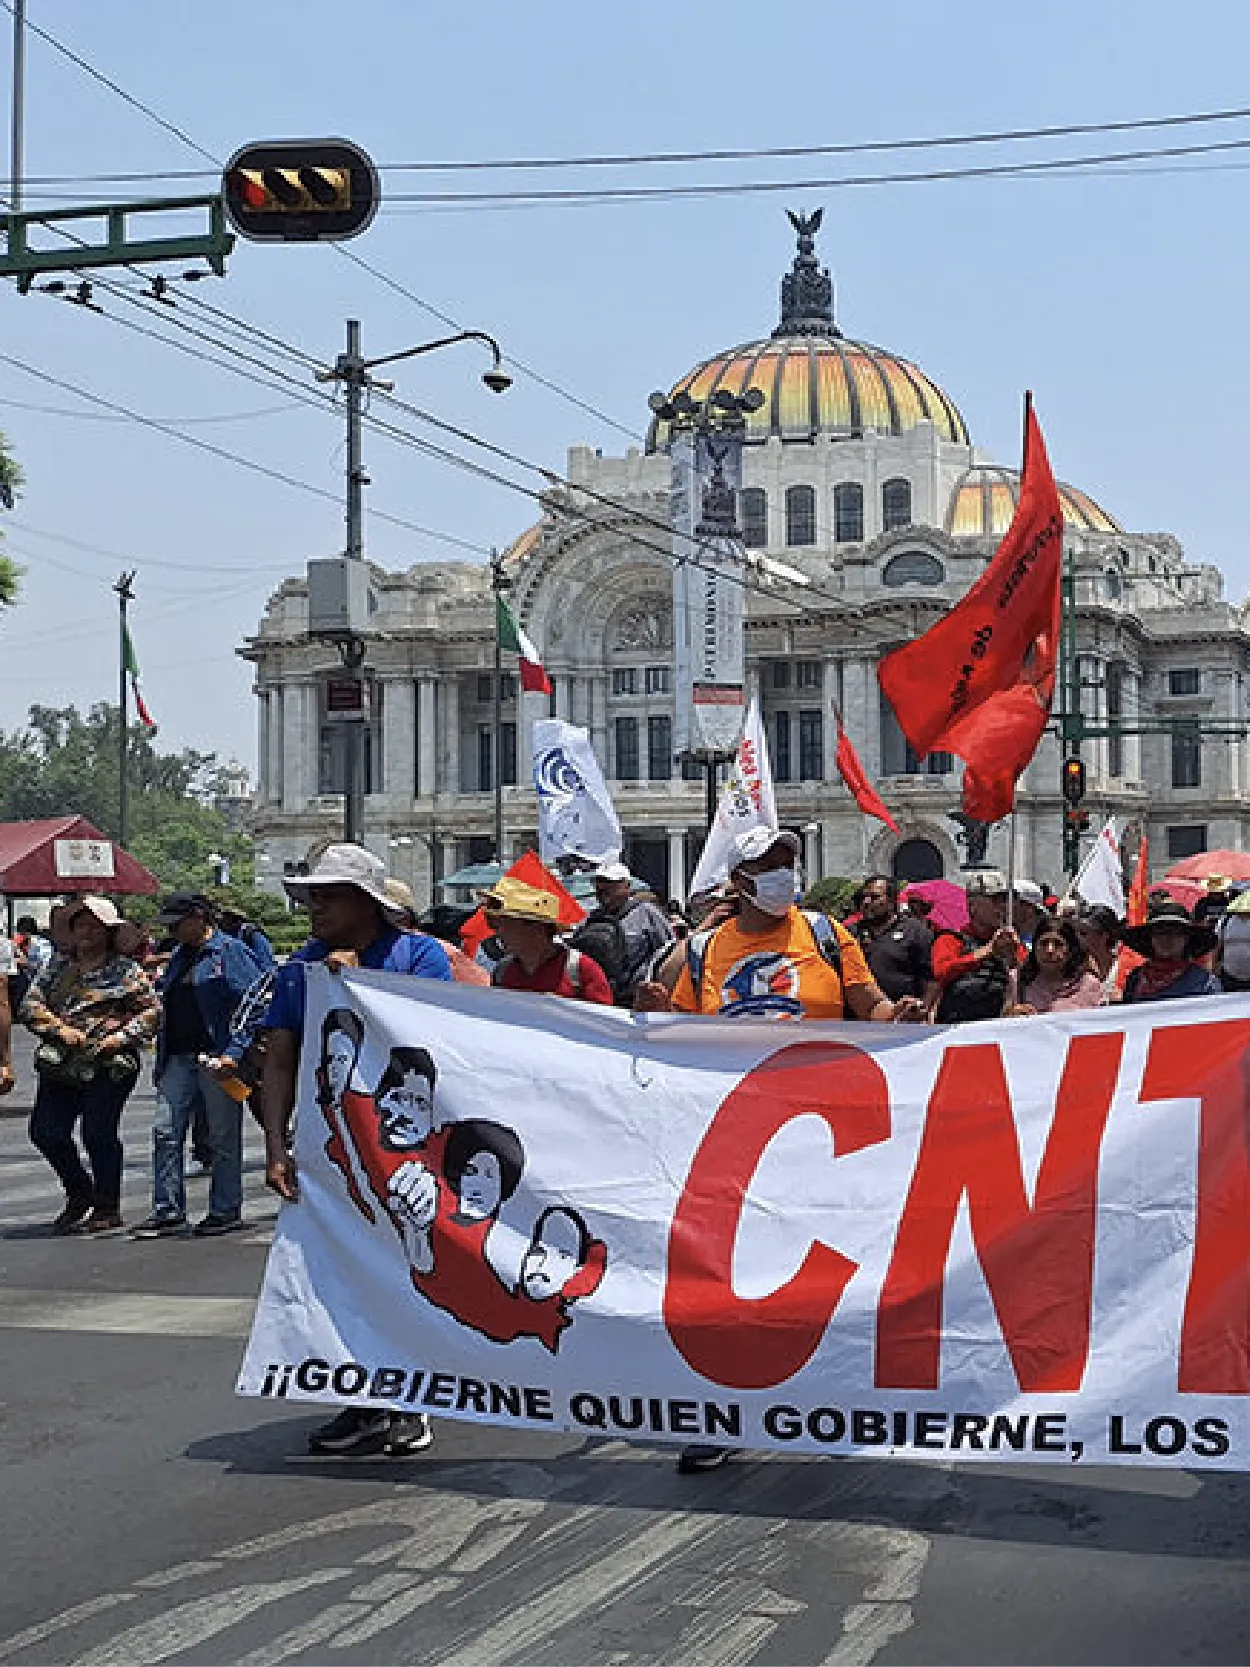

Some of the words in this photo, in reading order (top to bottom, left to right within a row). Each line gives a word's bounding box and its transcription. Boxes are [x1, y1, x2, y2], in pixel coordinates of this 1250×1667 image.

[261, 1358, 554, 1421] ¡¡GOBIERNE
[570, 1393, 741, 1437] QUIEN
[764, 1404, 1083, 1462] GOBIERNE,
[1109, 1415, 1230, 1456] LOS
